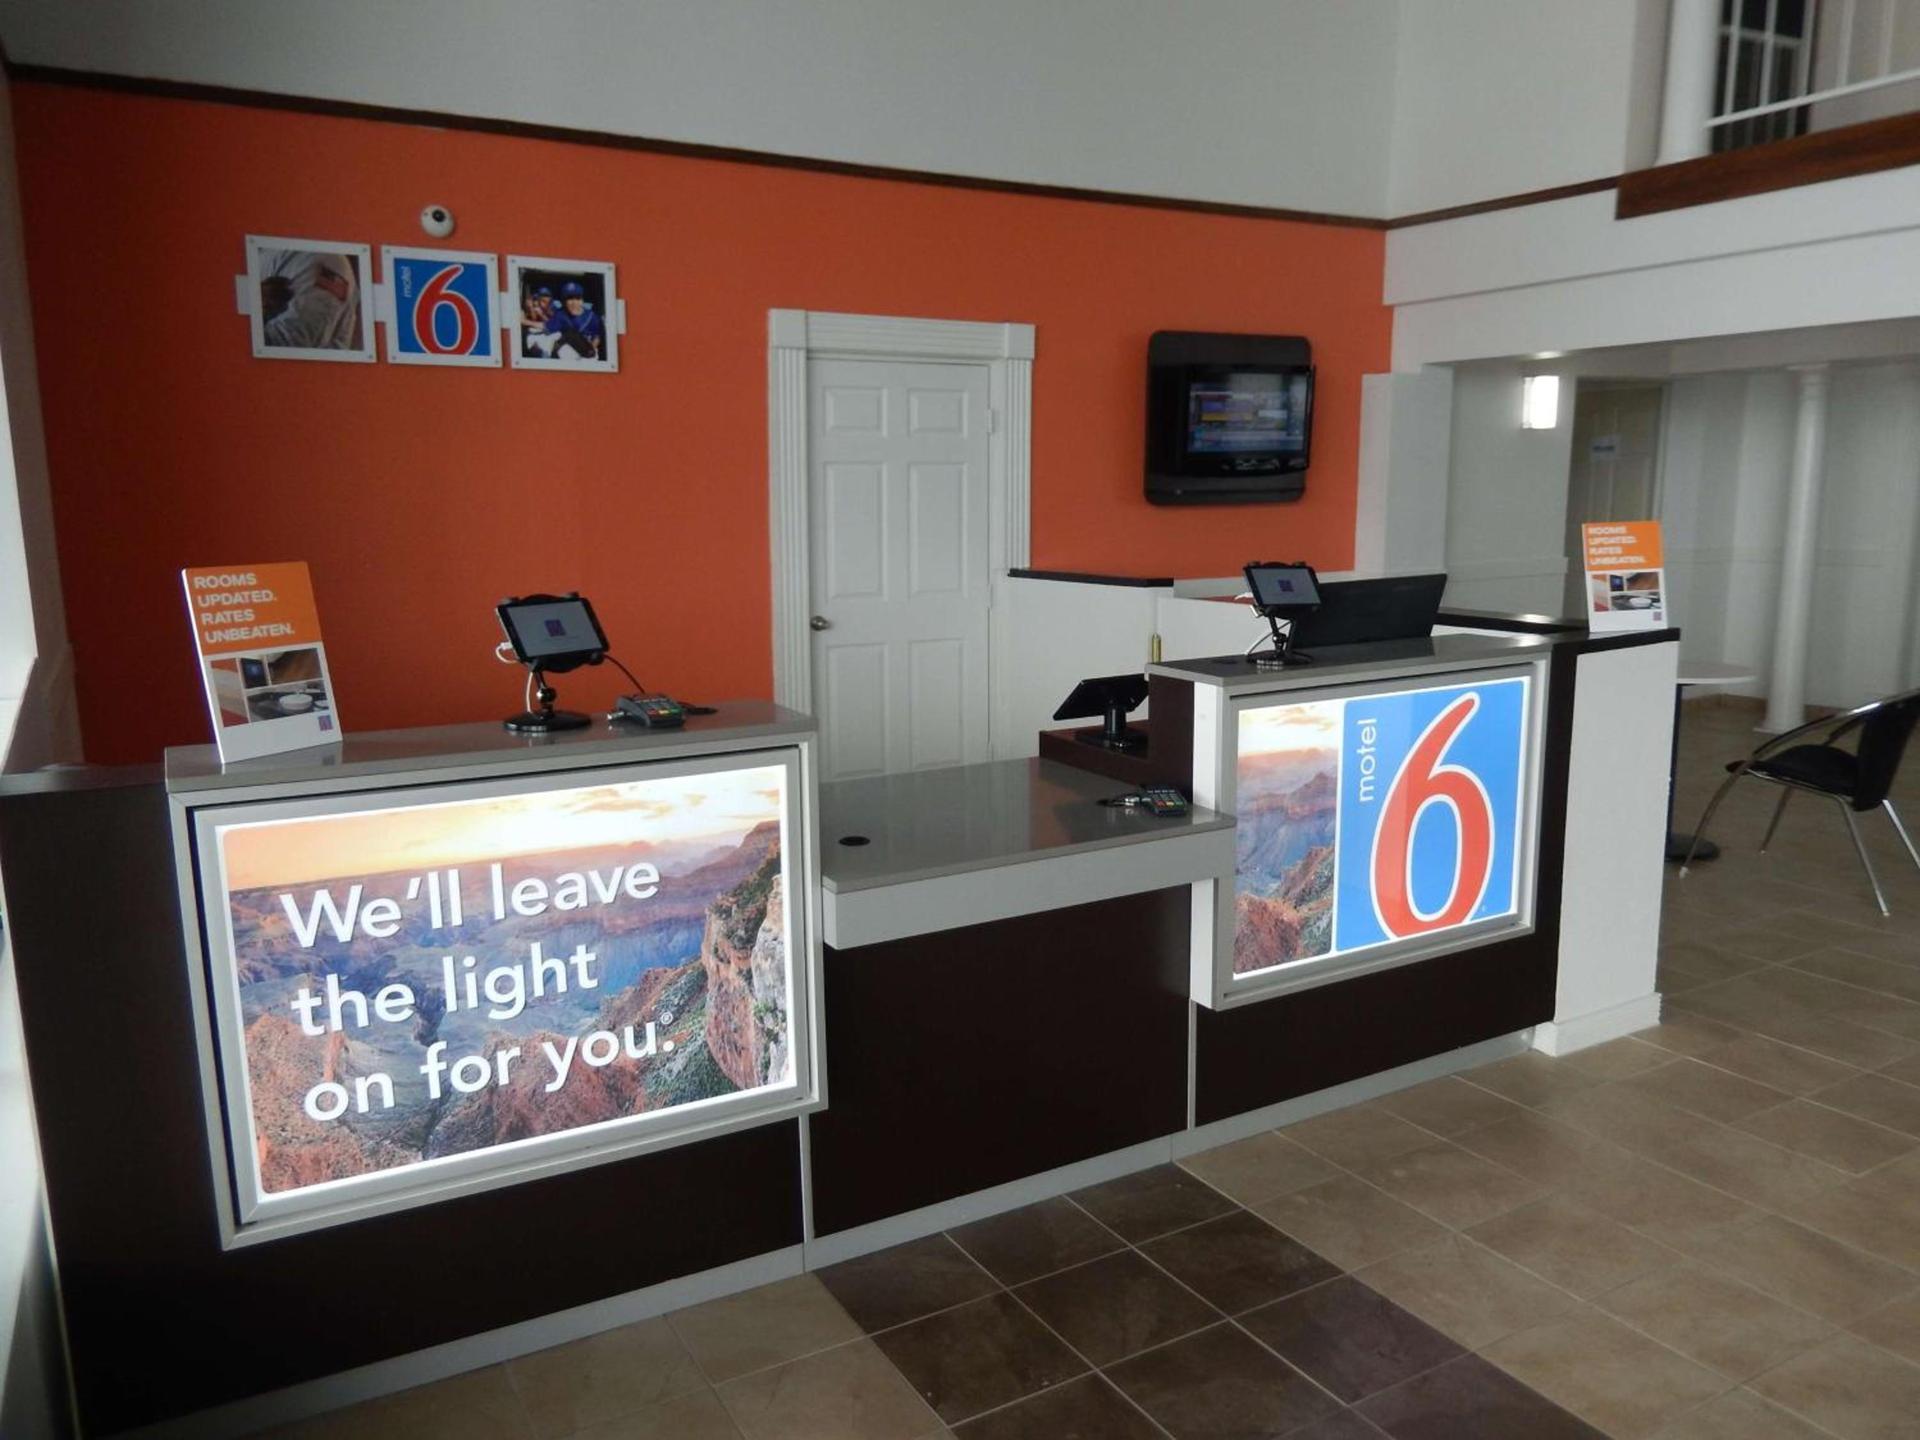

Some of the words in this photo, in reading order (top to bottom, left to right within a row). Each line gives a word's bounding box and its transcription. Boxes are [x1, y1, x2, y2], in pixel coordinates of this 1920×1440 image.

[401, 266, 412, 297] motel
[414, 264, 479, 354] 6
[194, 573, 257, 588] ROOMS
[198, 589, 277, 606] UPDATED.
[202, 609, 254, 624] RATES
[206, 624, 294, 642] UNBEATEN.
[1357, 717, 1378, 802] motel
[1369, 691, 1496, 942] 6
[280, 868, 464, 949] We'll
[491, 860, 661, 920] leave
[291, 974, 416, 1038] the
[442, 942, 599, 1021] light
[304, 1071, 396, 1122] on
[420, 1041, 522, 1100] for
